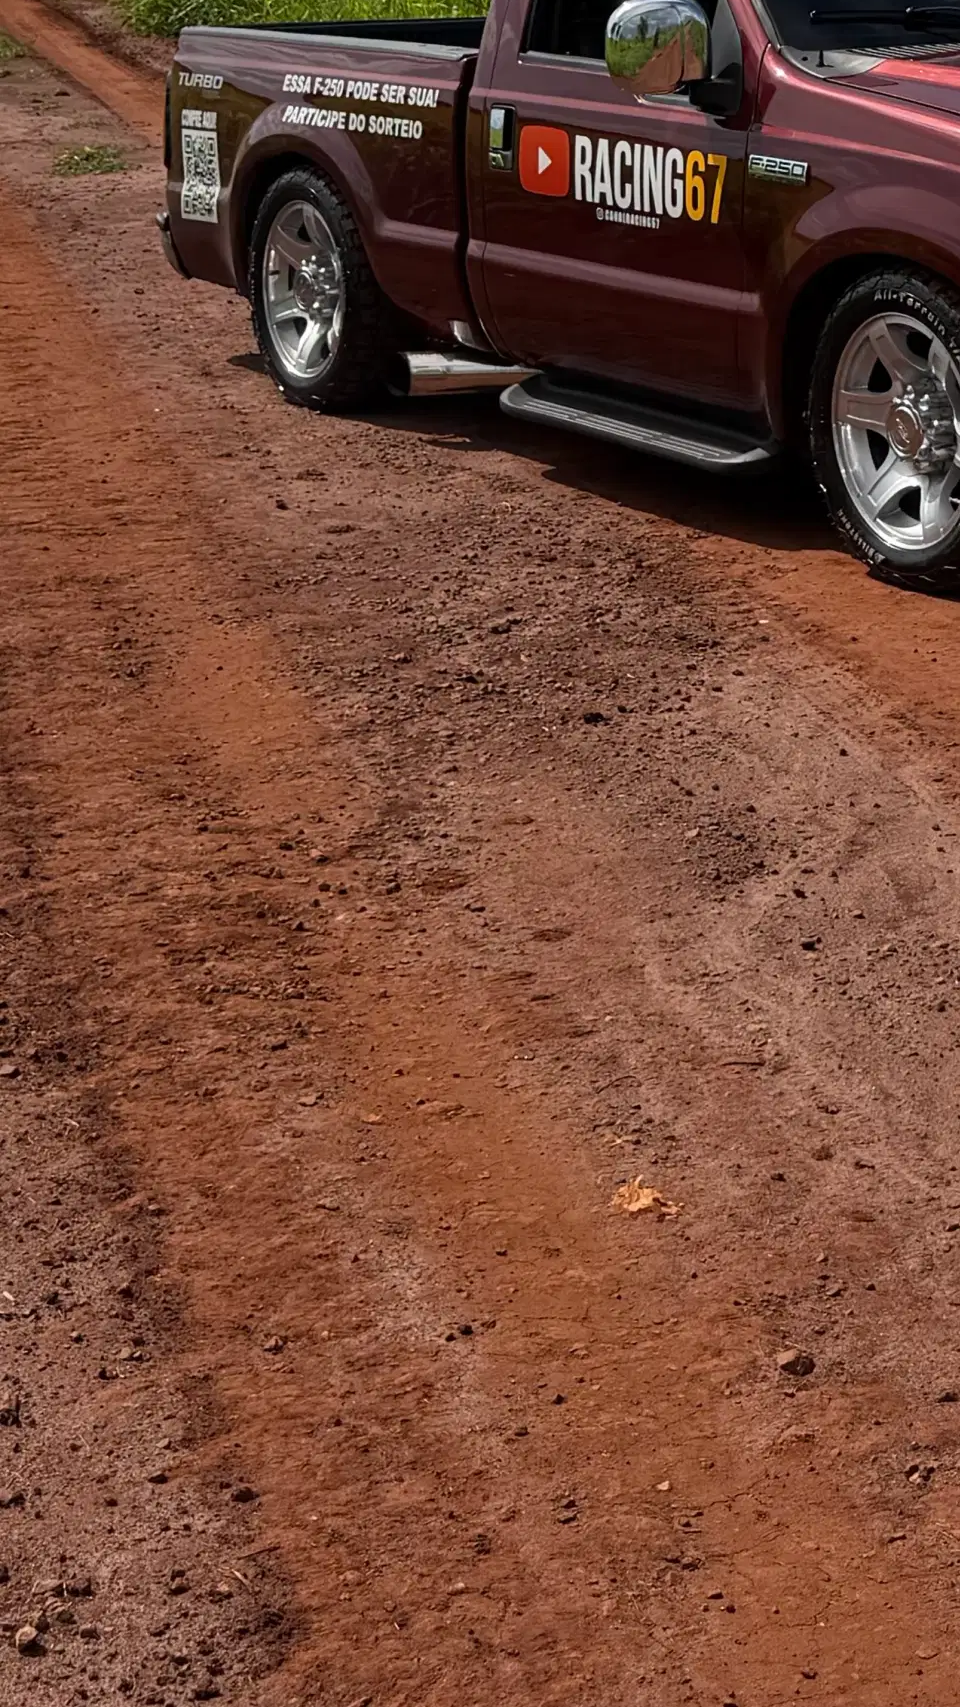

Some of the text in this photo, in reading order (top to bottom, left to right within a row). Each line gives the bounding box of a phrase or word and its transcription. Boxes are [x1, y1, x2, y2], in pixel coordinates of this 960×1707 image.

[178, 72, 224, 90] TURBO
[282, 74, 440, 108] ESSA F-250 PODE SER SUA!
[282, 105, 423, 139] PARTICIPE DO SORTEIO
[750, 156, 806, 178] F-250
